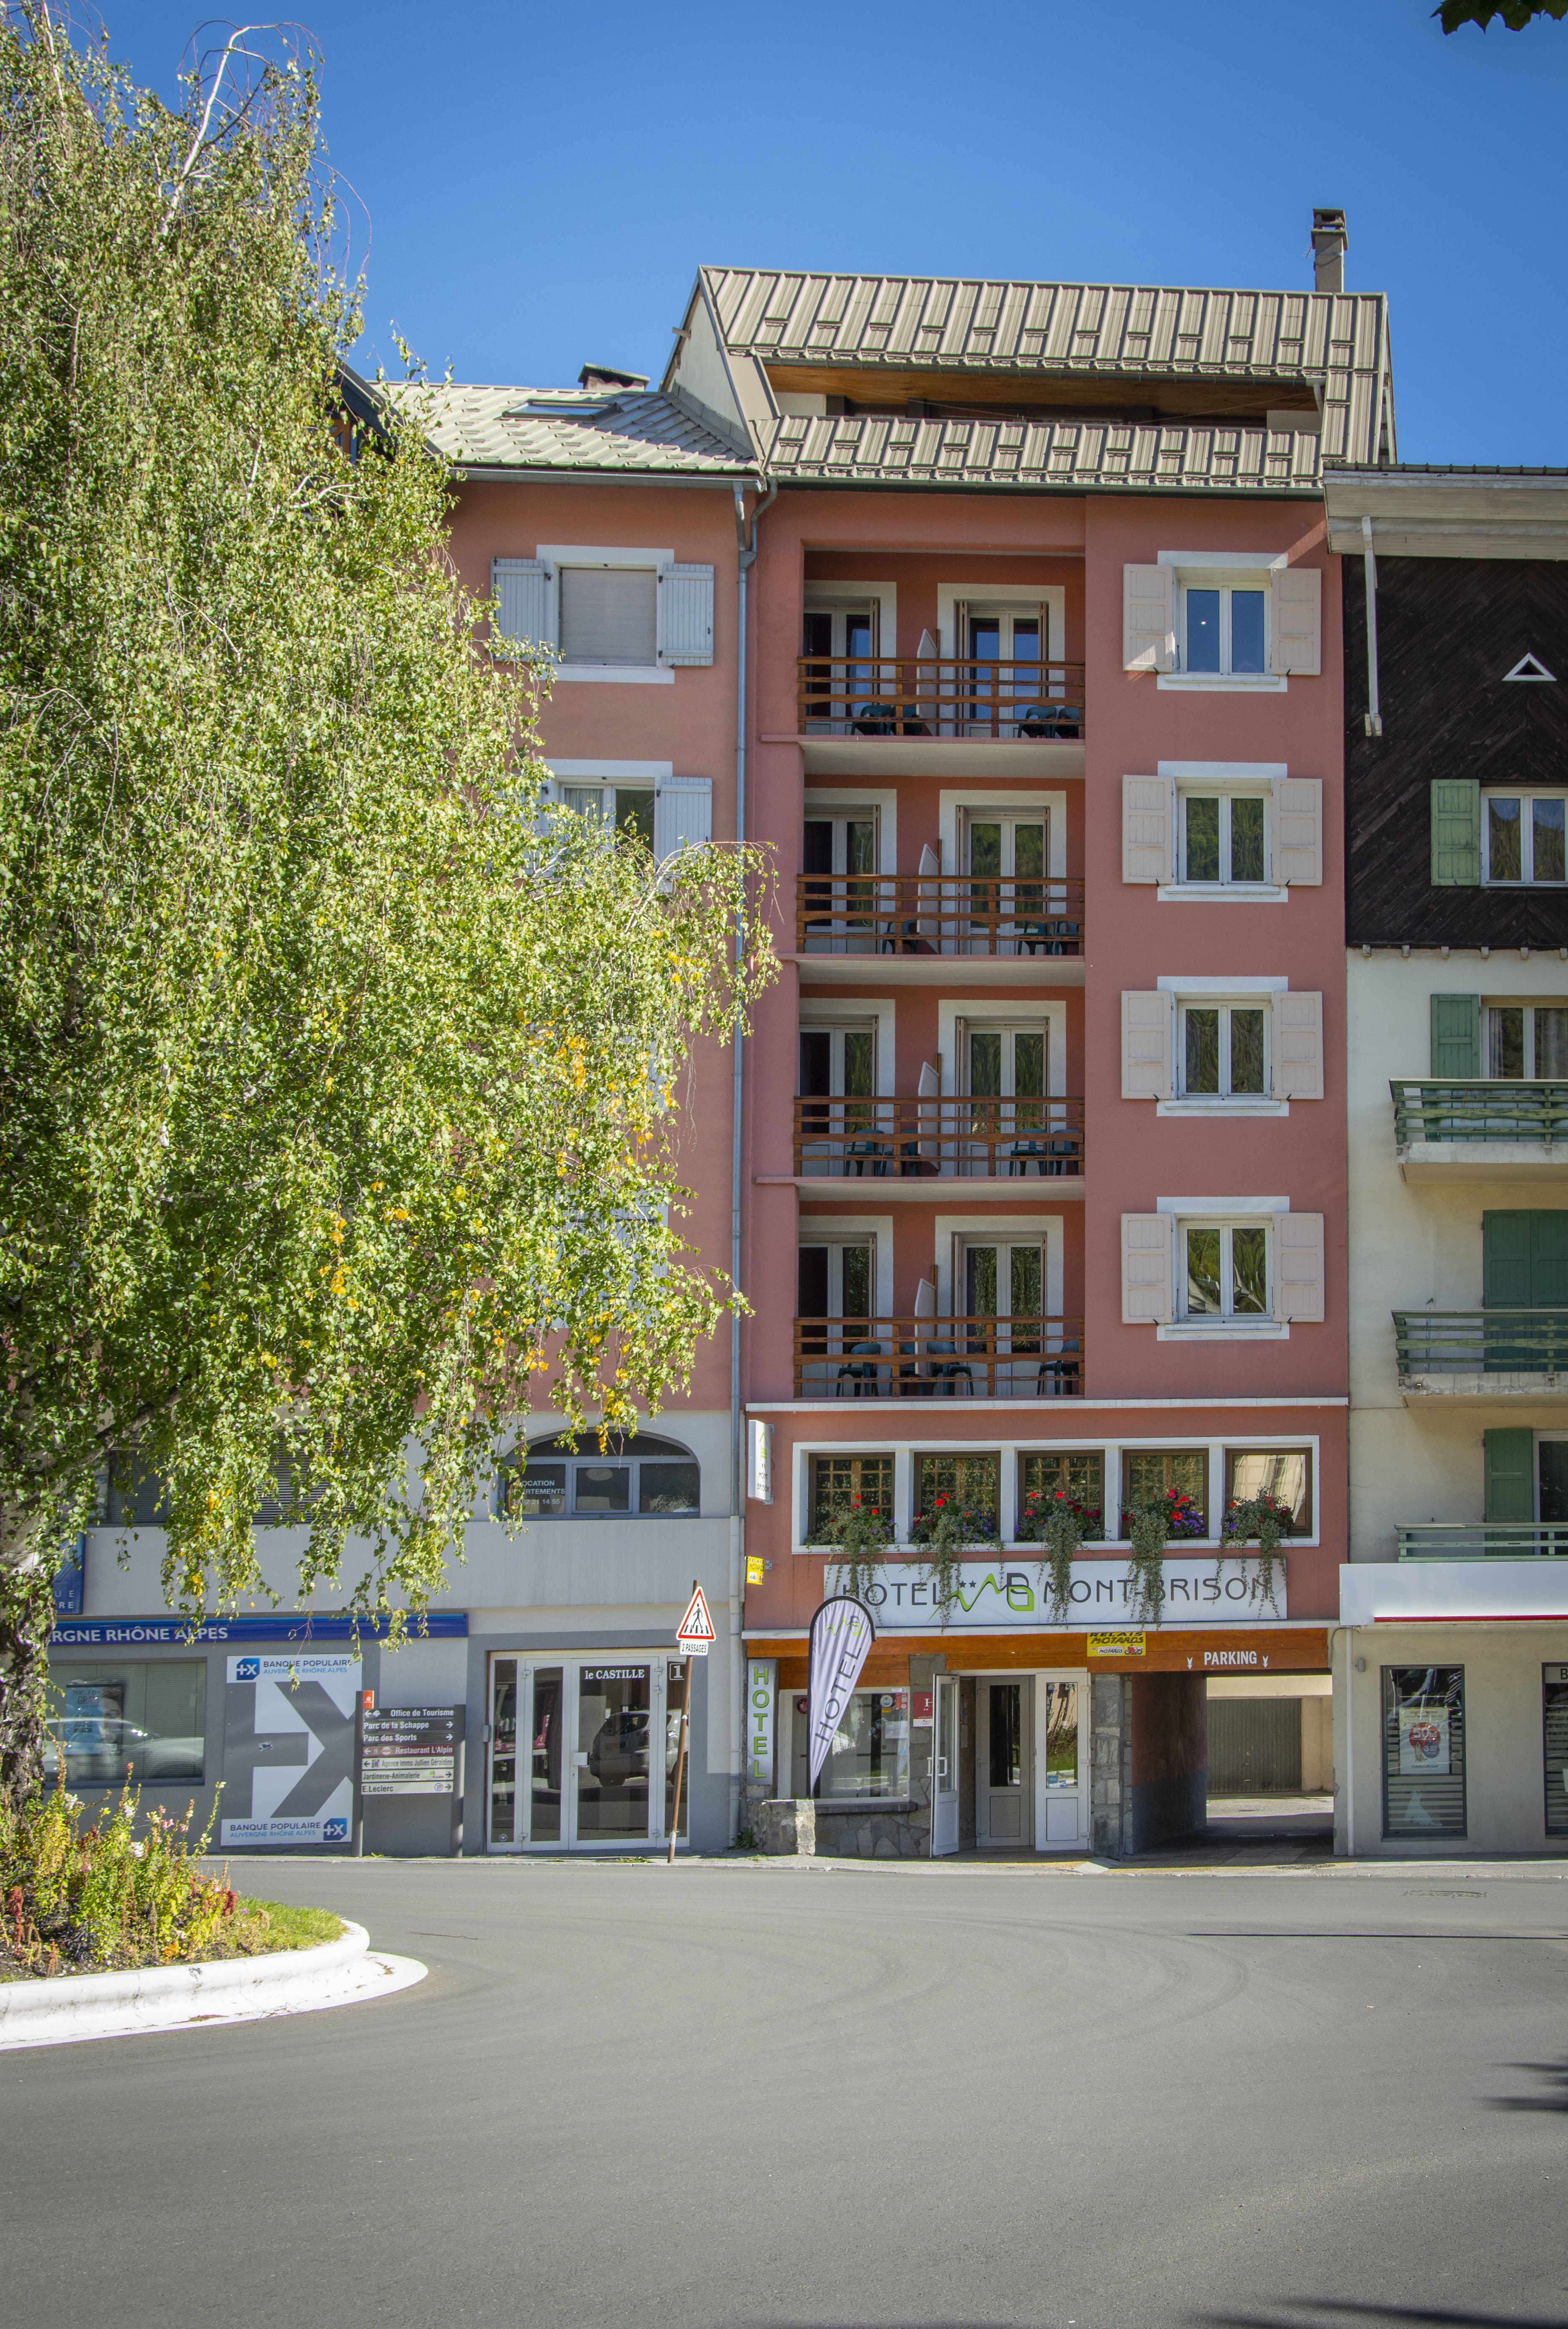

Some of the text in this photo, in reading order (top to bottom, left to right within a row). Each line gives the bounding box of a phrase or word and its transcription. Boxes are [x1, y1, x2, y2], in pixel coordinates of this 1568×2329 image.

[843, 1583, 945, 1606] HOTEL
[106, 1626, 170, 1641] RHÔNE
[174, 1627, 228, 1640] ALPES
[682, 1644, 707, 1653] 2 PASSAGES
[1204, 1651, 1257, 1665] PARKING
[585, 1669, 645, 1680] le CASTILLE
[815, 1648, 862, 1742] HOTEL
[752, 1667, 770, 1778] HOTEL
[395, 1734, 417, 1742] Sports
[431, 1746, 453, 1755] L'Alpin
[271, 1822, 321, 1830] POPULAIRE
